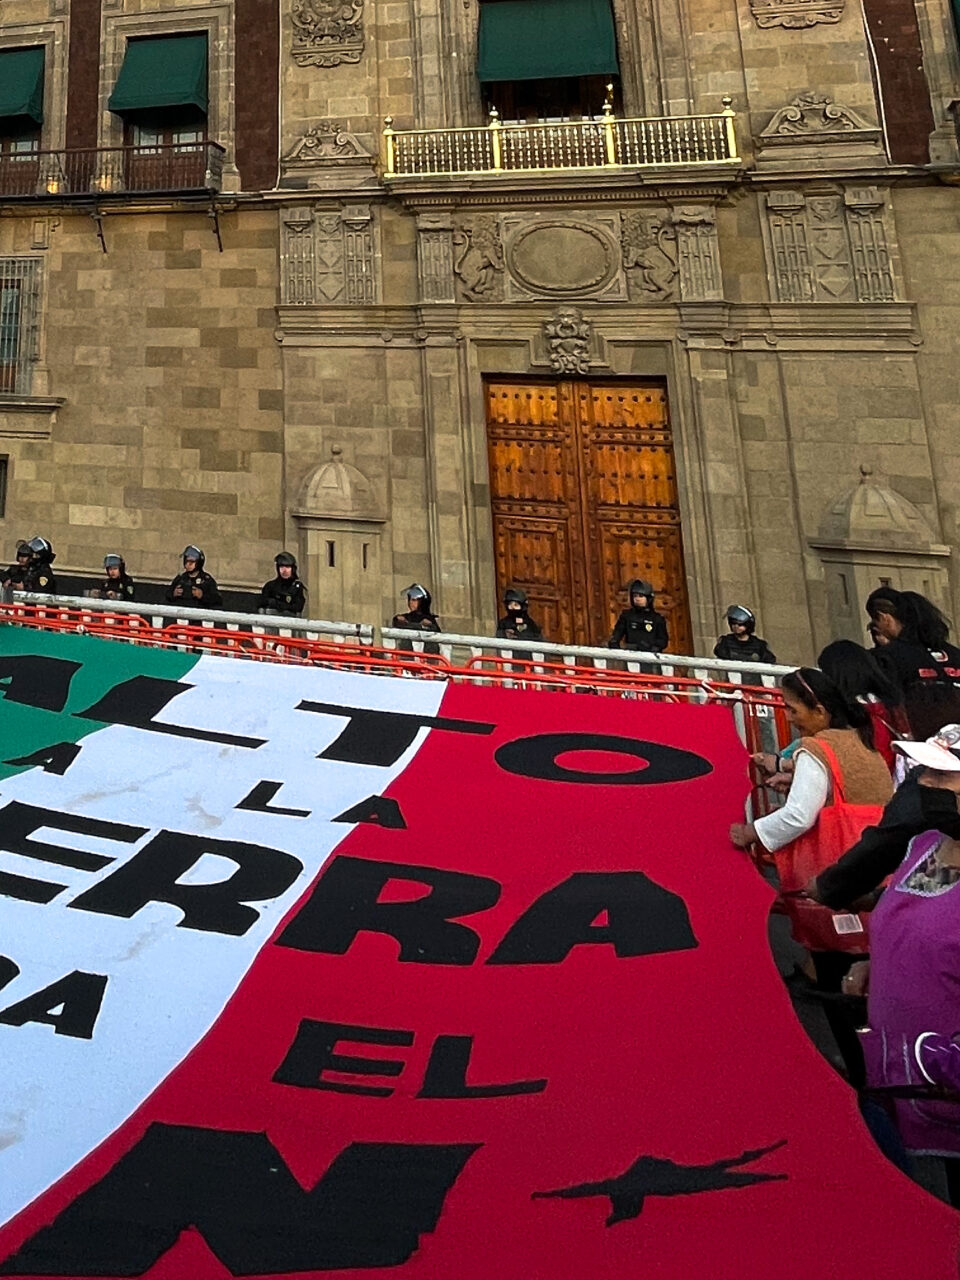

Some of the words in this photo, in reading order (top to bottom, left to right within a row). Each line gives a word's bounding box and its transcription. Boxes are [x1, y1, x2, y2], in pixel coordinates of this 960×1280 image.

[1, 741, 82, 776] A
[234, 780, 407, 829] LA
[271, 1018, 547, 1099] EL
